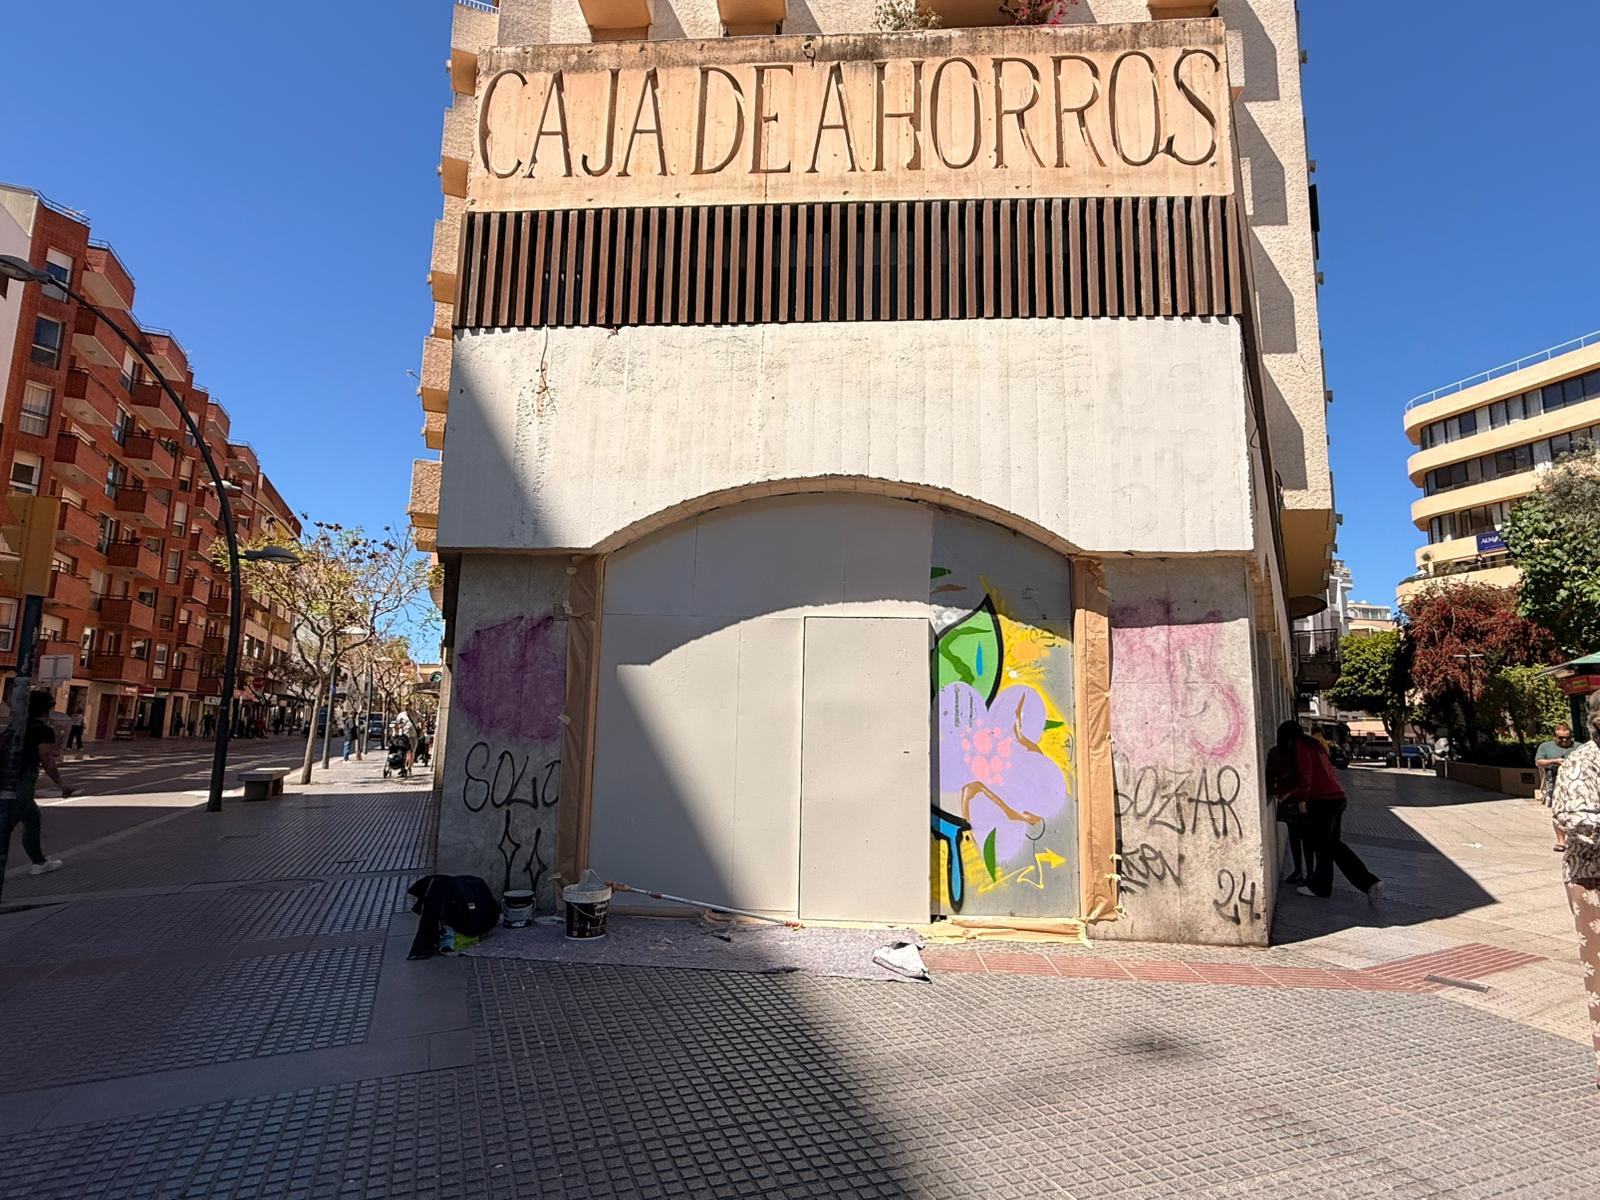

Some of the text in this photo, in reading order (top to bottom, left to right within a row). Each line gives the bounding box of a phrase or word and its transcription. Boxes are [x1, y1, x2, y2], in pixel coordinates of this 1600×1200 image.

[478, 48, 1220, 179] CAJA DE AHORROS
